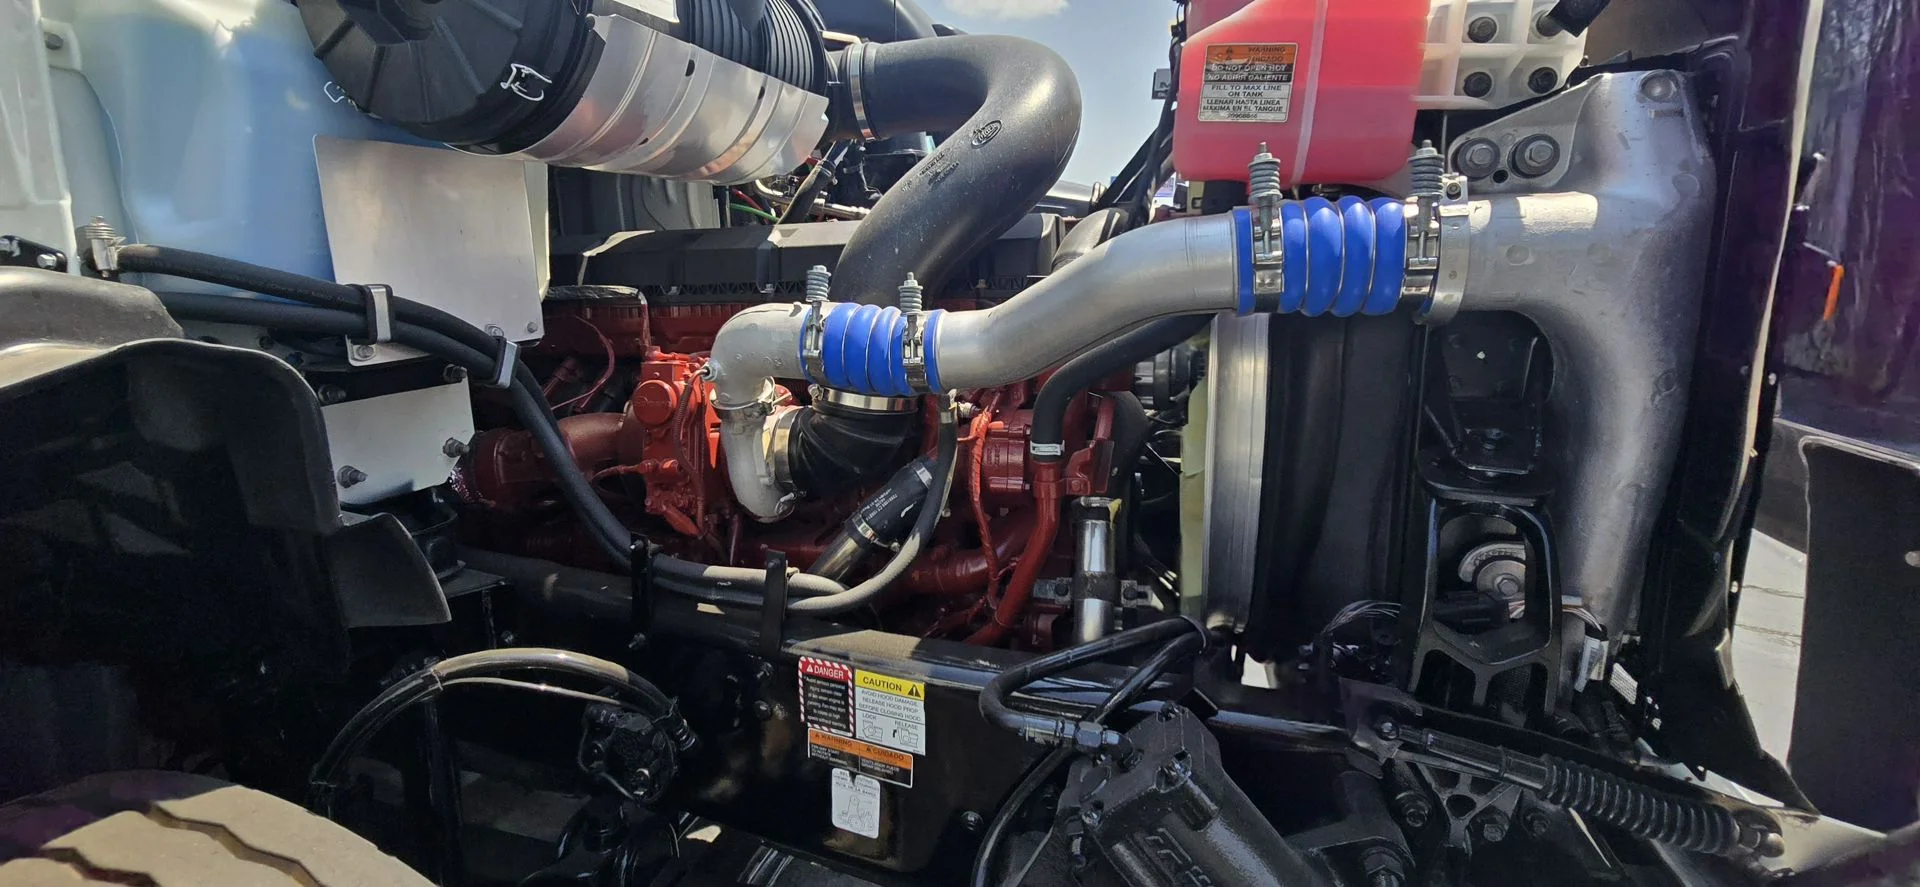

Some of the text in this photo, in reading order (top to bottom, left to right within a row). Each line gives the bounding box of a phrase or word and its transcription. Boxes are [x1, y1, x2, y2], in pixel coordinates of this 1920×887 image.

[1211, 64, 1287, 72] DO NOT OPEN HOT
[814, 665, 844, 679] DANGER
[862, 676, 902, 692] CAUTION
[861, 690, 877, 698] AVOID
[878, 693, 894, 701] HOOD
[862, 697, 885, 706] RELEASE
[886, 702, 902, 710] HOOD
[859, 703, 880, 711] BEFORE
[880, 707, 904, 718] CLOSING
[894, 720, 918, 730] RELEASE
[821, 734, 852, 747] WARNING
[871, 747, 904, 761] CUIDADO
